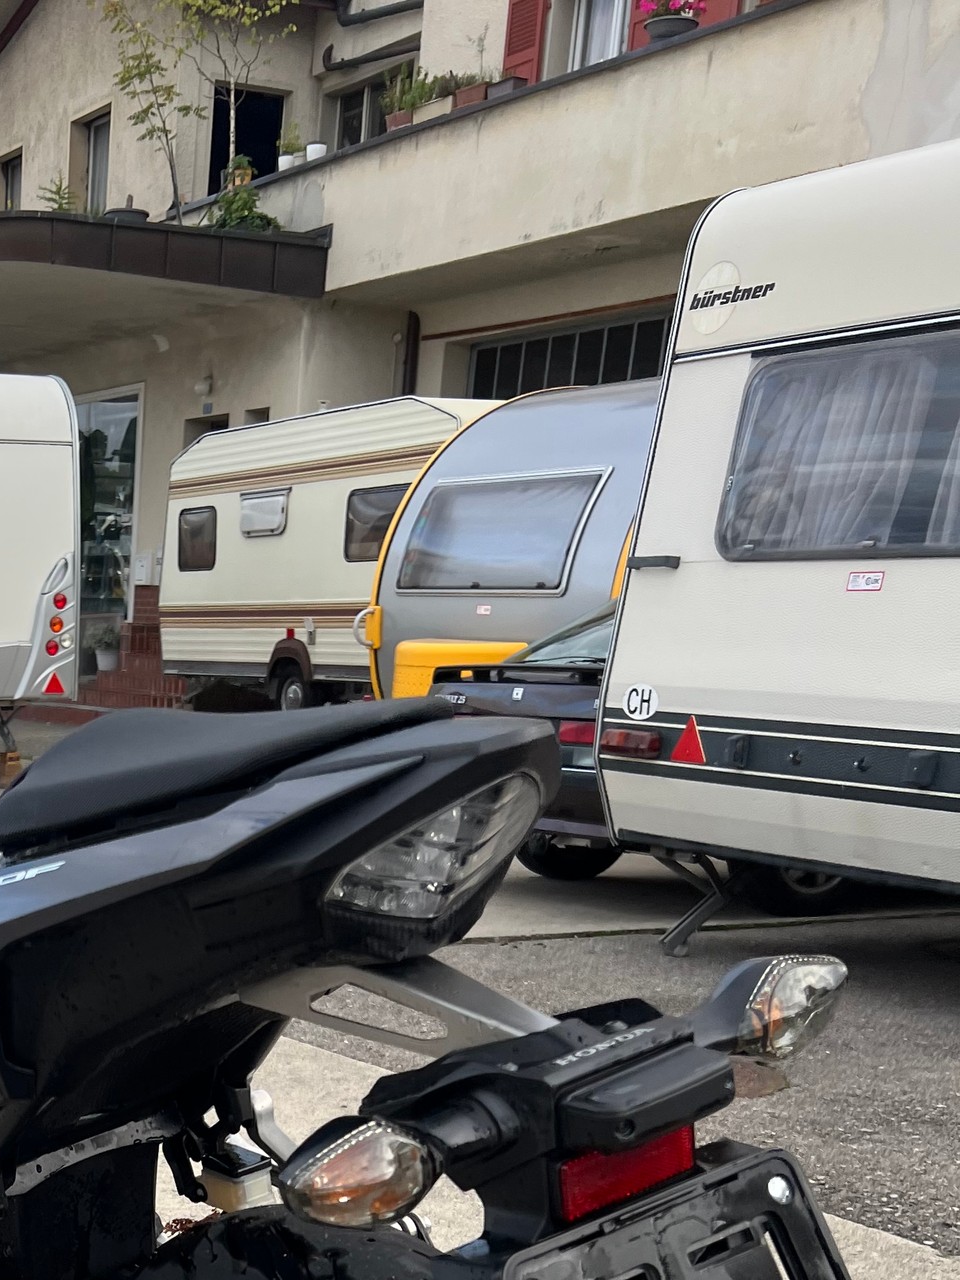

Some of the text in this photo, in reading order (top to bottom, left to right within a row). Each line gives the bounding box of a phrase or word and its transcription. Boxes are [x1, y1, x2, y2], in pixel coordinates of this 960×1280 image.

[689, 282, 776, 311] bürstner
[626, 687, 653, 716] CH
[553, 1027, 656, 1066] HONDA
